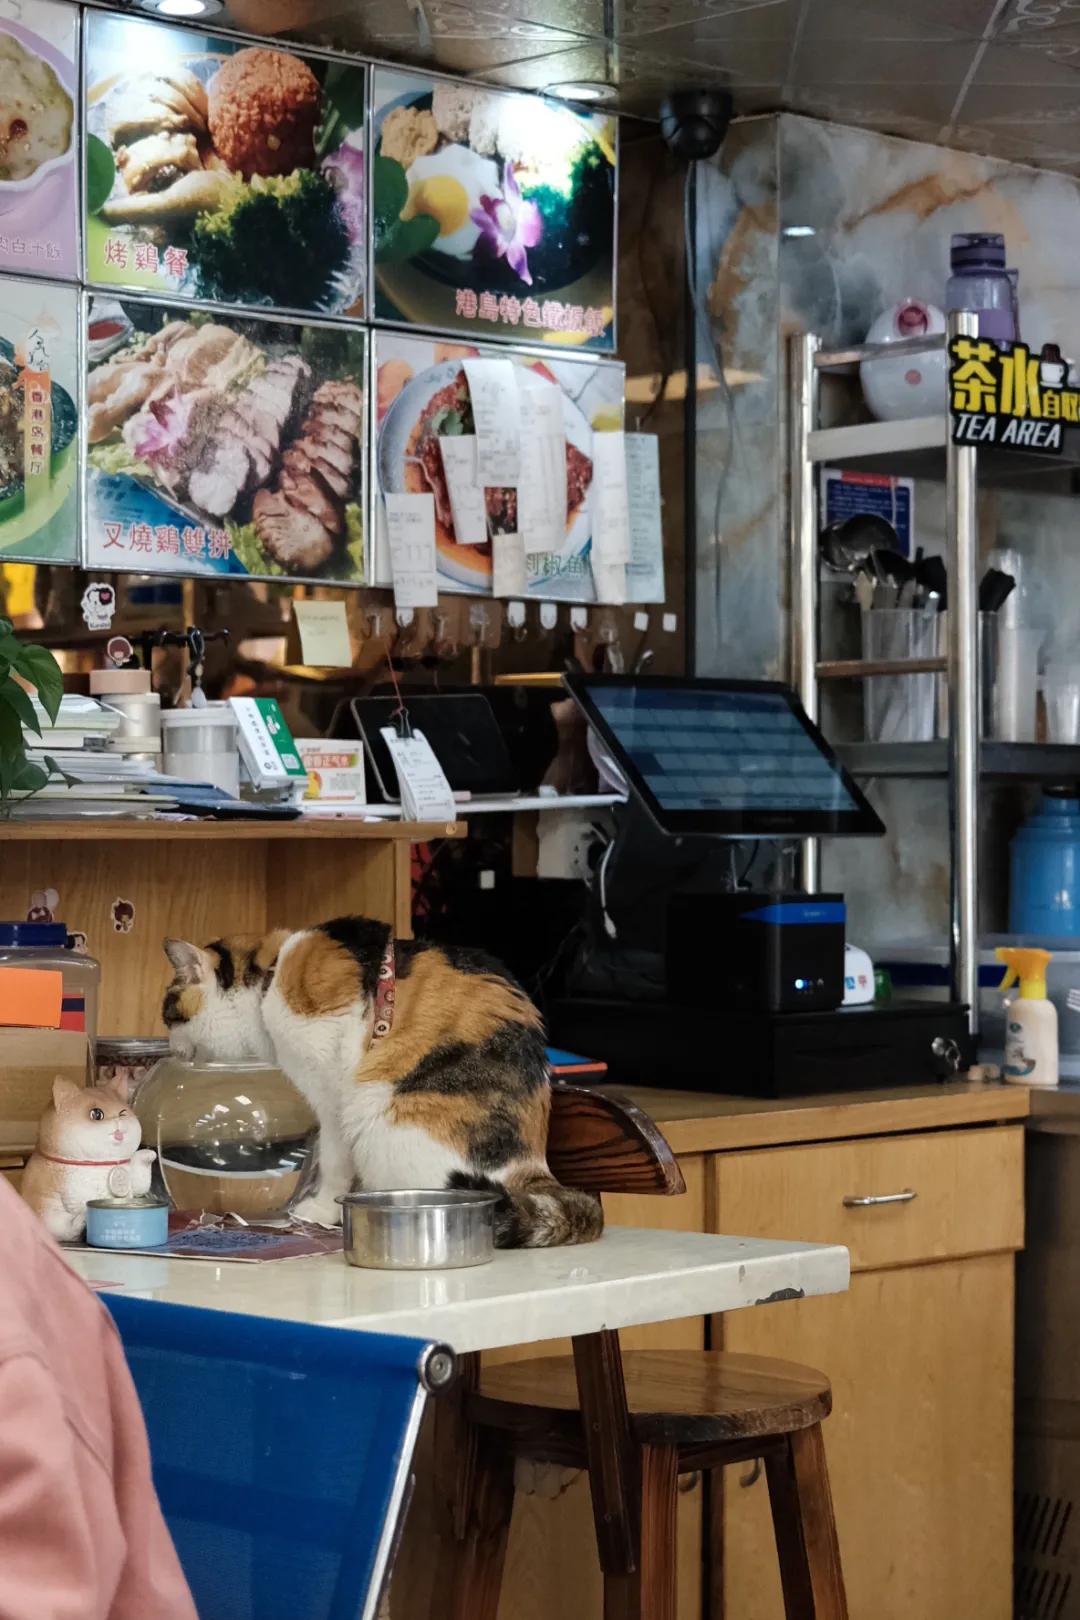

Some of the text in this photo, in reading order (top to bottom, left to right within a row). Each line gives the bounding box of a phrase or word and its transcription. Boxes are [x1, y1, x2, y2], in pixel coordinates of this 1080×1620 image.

[952, 340, 1042, 417] 茶水
[955, 413, 1062, 448] TEA AREA
